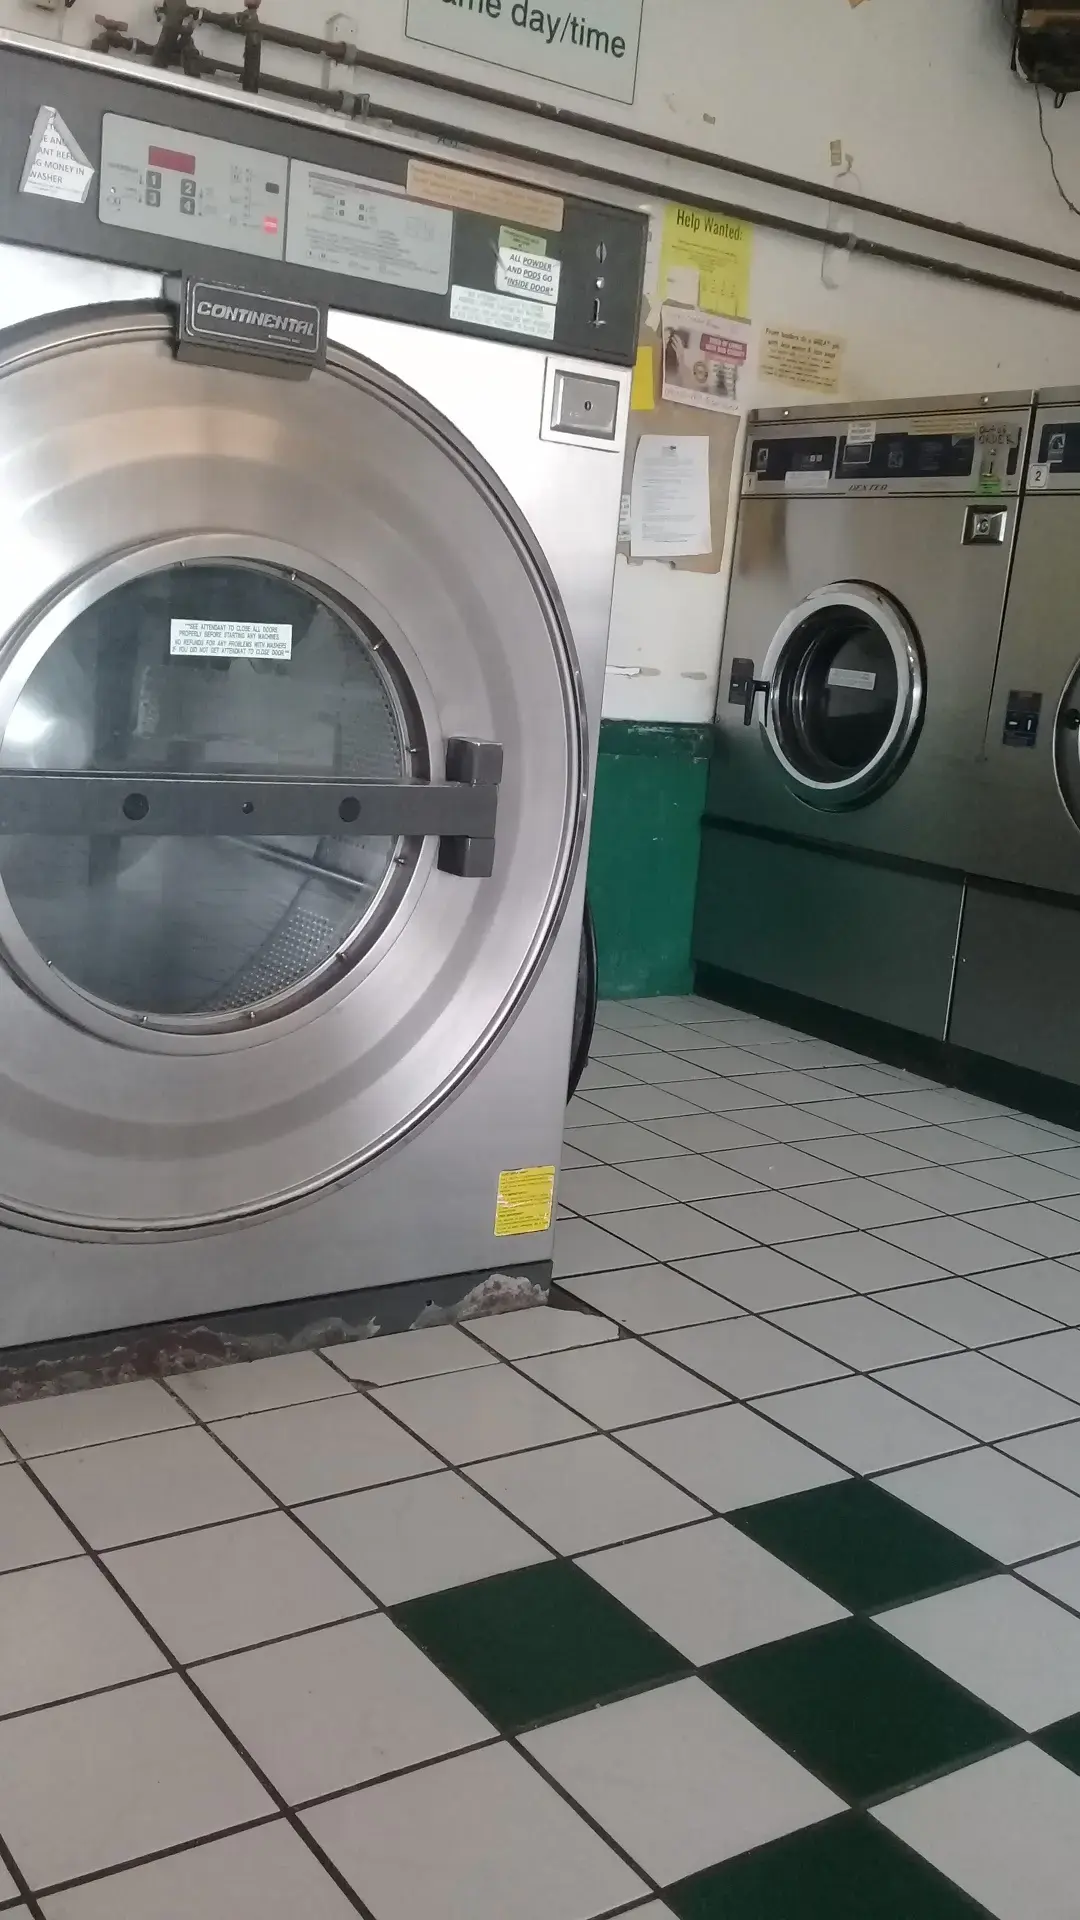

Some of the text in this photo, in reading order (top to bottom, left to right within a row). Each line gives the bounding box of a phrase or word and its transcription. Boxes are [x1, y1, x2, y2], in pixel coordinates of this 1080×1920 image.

[511, 0, 626, 58] day/time
[45, 160, 74, 172] MONEY
[76, 168, 84, 176] IN
[676, 208, 744, 240] Help Wanted:
[509, 254, 552, 271] ALL POWDER
[506, 265, 552, 282] AND PODS GO
[196, 301, 314, 336] CONTINENTAL
[1034, 470, 1042, 482] 2
